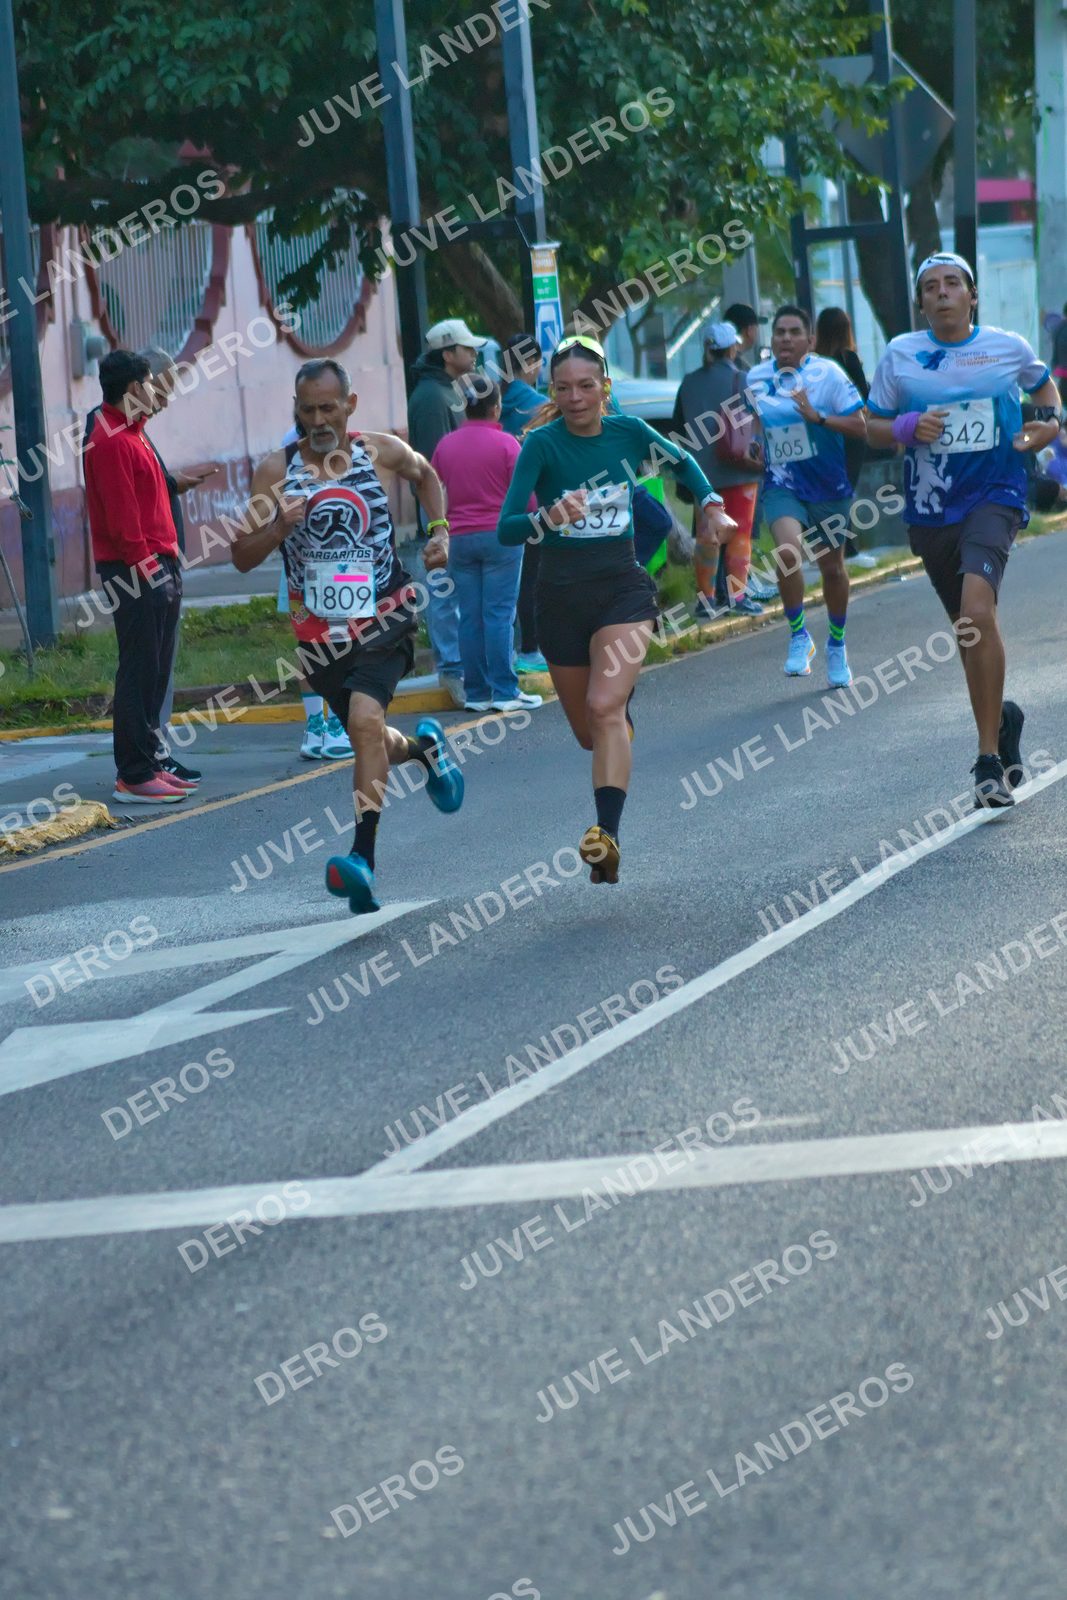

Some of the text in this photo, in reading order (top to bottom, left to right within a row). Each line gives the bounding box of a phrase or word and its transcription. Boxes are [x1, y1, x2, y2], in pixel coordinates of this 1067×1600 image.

[940, 421, 986, 447] 542
[774, 440, 803, 458] 605
[310, 586, 372, 610] 1809
